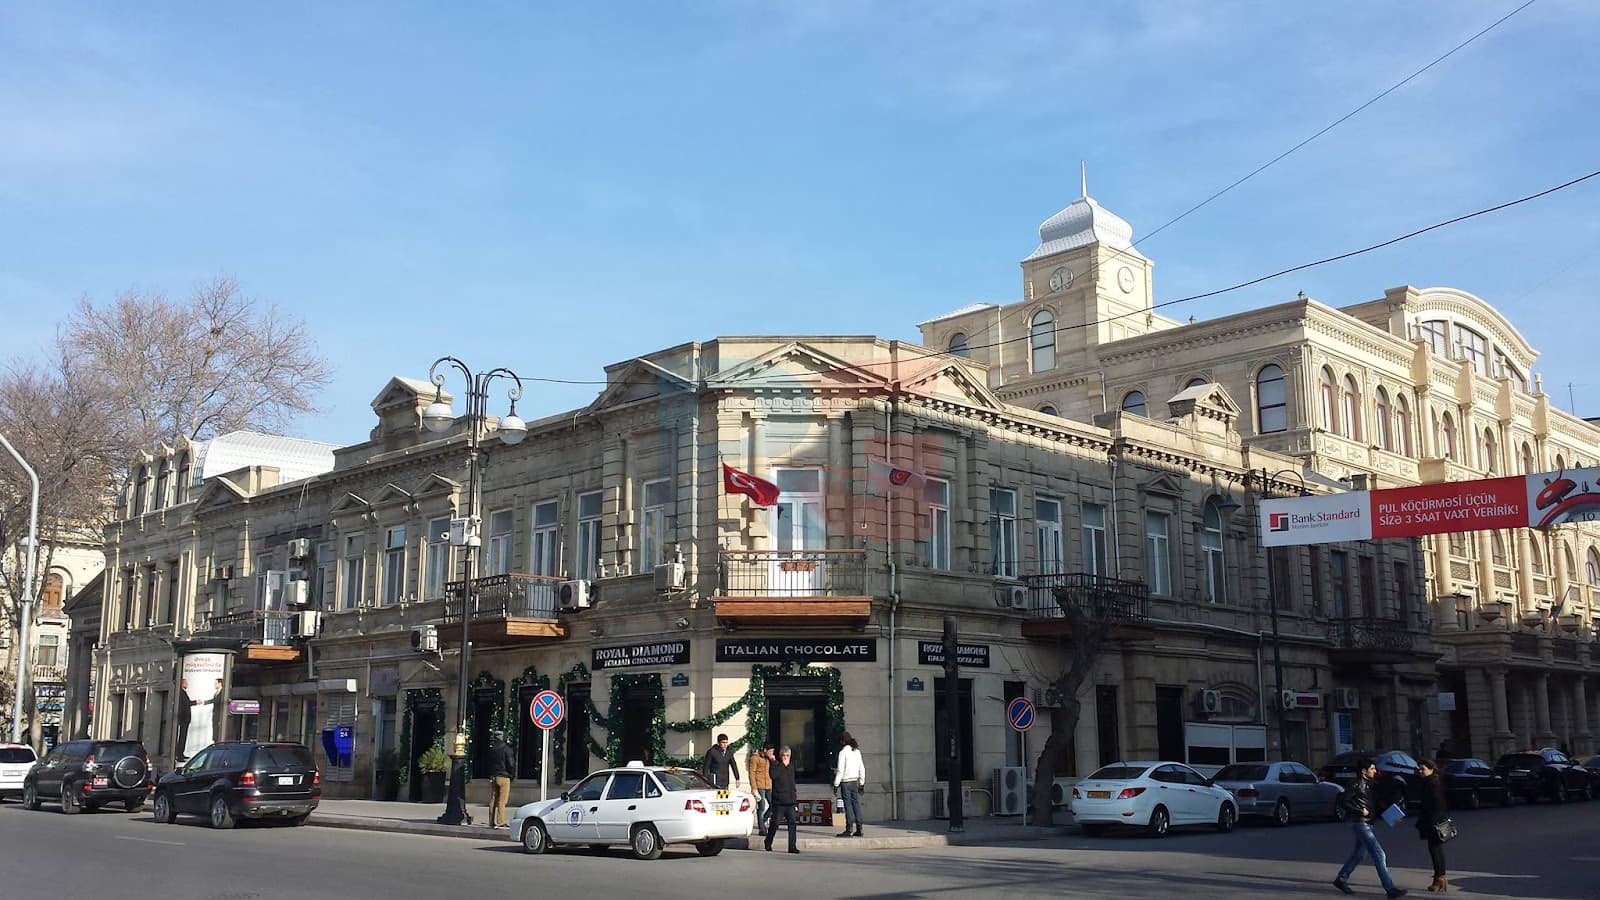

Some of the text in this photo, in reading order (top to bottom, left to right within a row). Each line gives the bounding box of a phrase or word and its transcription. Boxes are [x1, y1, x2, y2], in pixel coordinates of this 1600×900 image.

[1379, 503, 1398, 514] PUL
[1465, 492, 1496, 508] ÜÇÜN
[1291, 508, 1360, 524] Bank Standard
[1379, 503, 1519, 526] SİZƏ 3 SAAT VAXT VERİRİK!
[596, 643, 684, 660] ROYAL DIAMOND
[724, 645, 869, 655] ITALIAN CHOCOLATE
